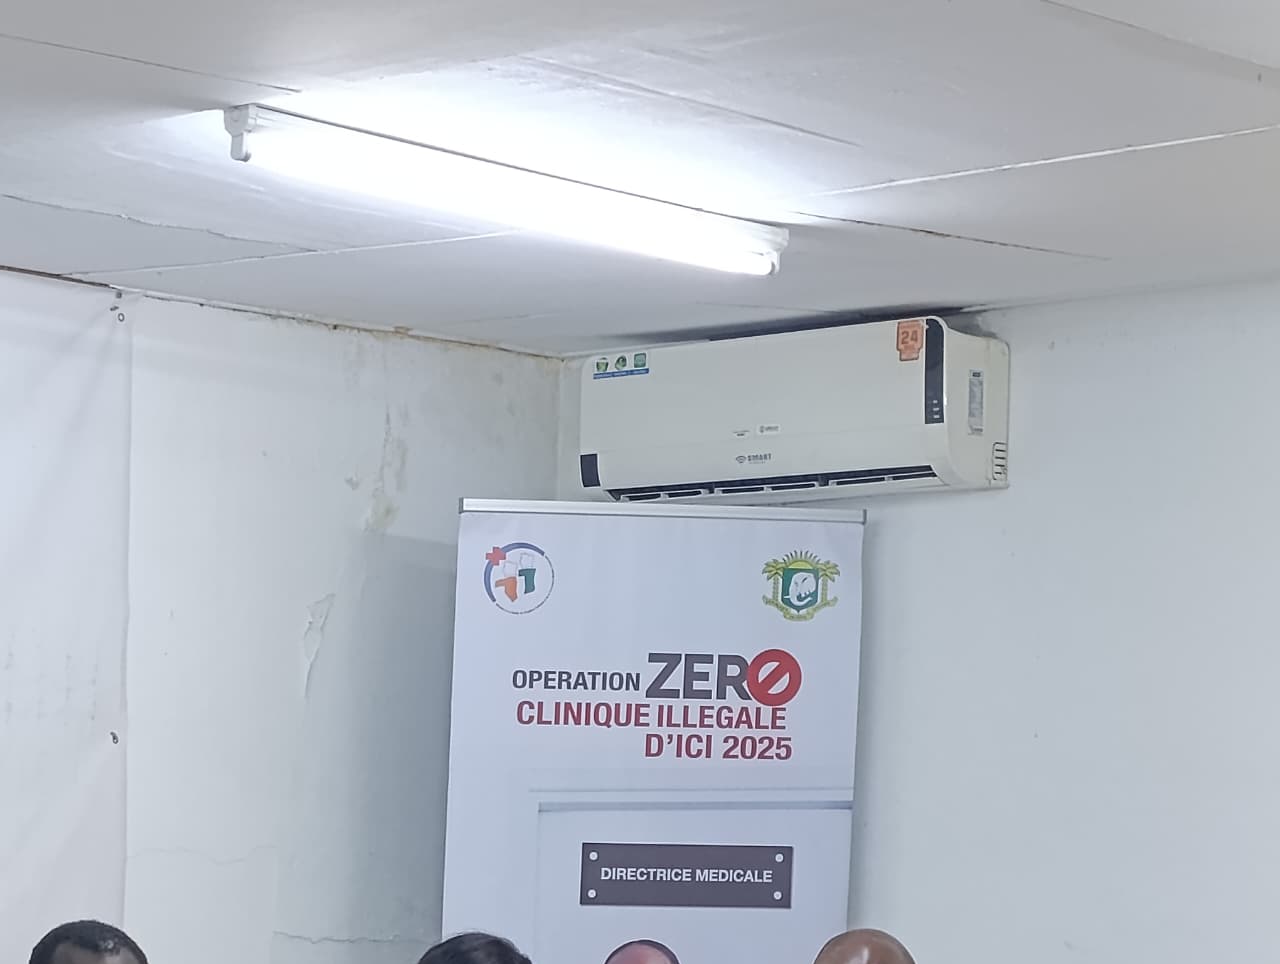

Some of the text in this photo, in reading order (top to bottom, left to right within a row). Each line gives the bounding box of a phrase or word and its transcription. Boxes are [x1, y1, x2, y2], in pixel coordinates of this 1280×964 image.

[901, 330, 919, 345] 24
[511, 648, 802, 707] OPERATION ZERO
[516, 700, 786, 730] CLINIQUE ILLEGALE
[722, 736, 793, 761] 2025
[600, 867, 773, 883] DIRECTRICE MEDICALE
